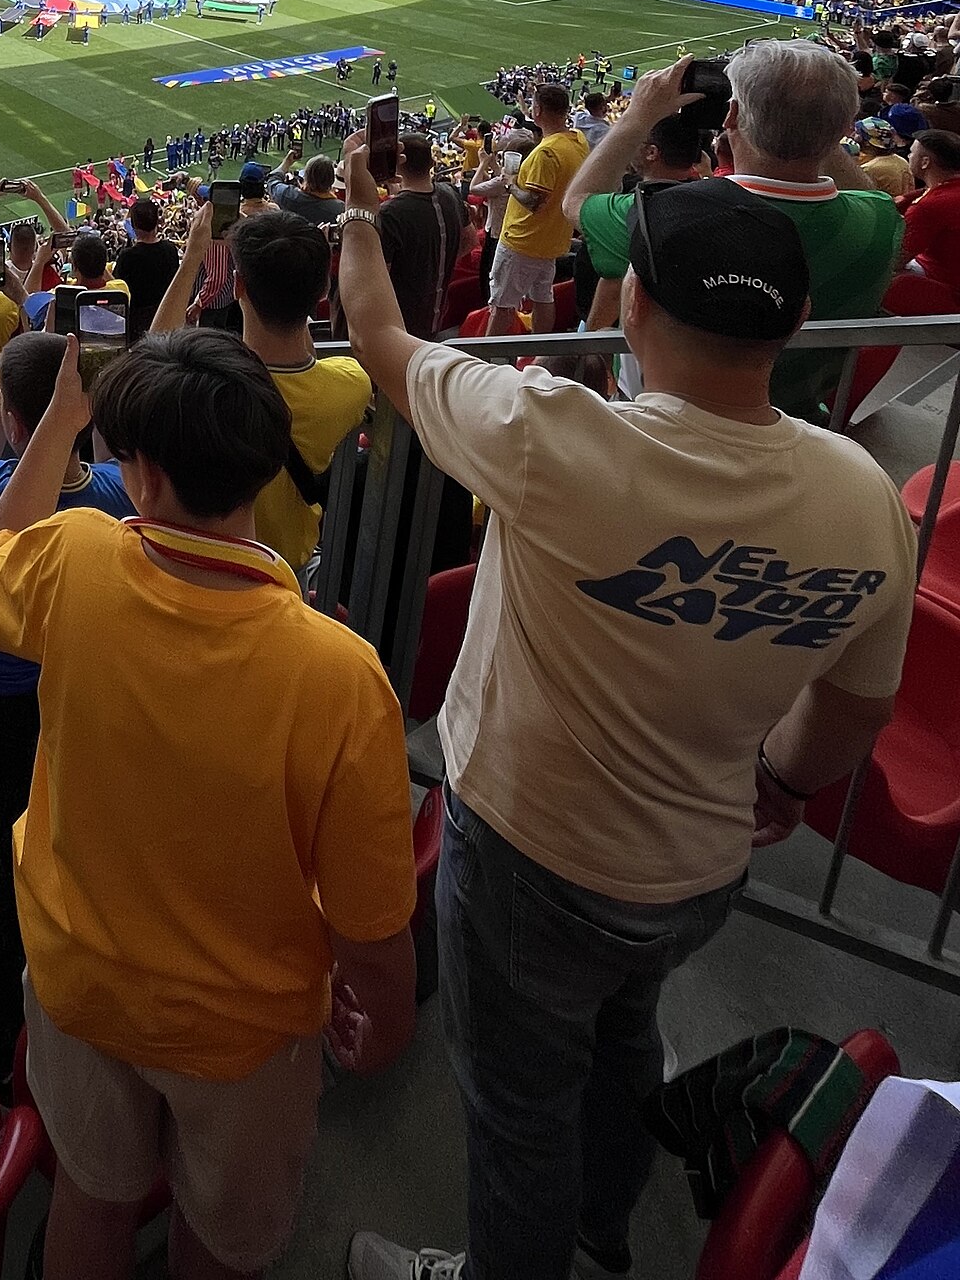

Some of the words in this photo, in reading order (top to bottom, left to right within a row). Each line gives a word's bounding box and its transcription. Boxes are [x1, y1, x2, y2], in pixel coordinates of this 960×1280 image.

[223, 54, 329, 76] MUNICH
[702, 273, 785, 310] MADHOUSE
[636, 535, 887, 597] NEVER
[575, 569, 856, 649] LATE
[713, 574, 863, 621] TOO
